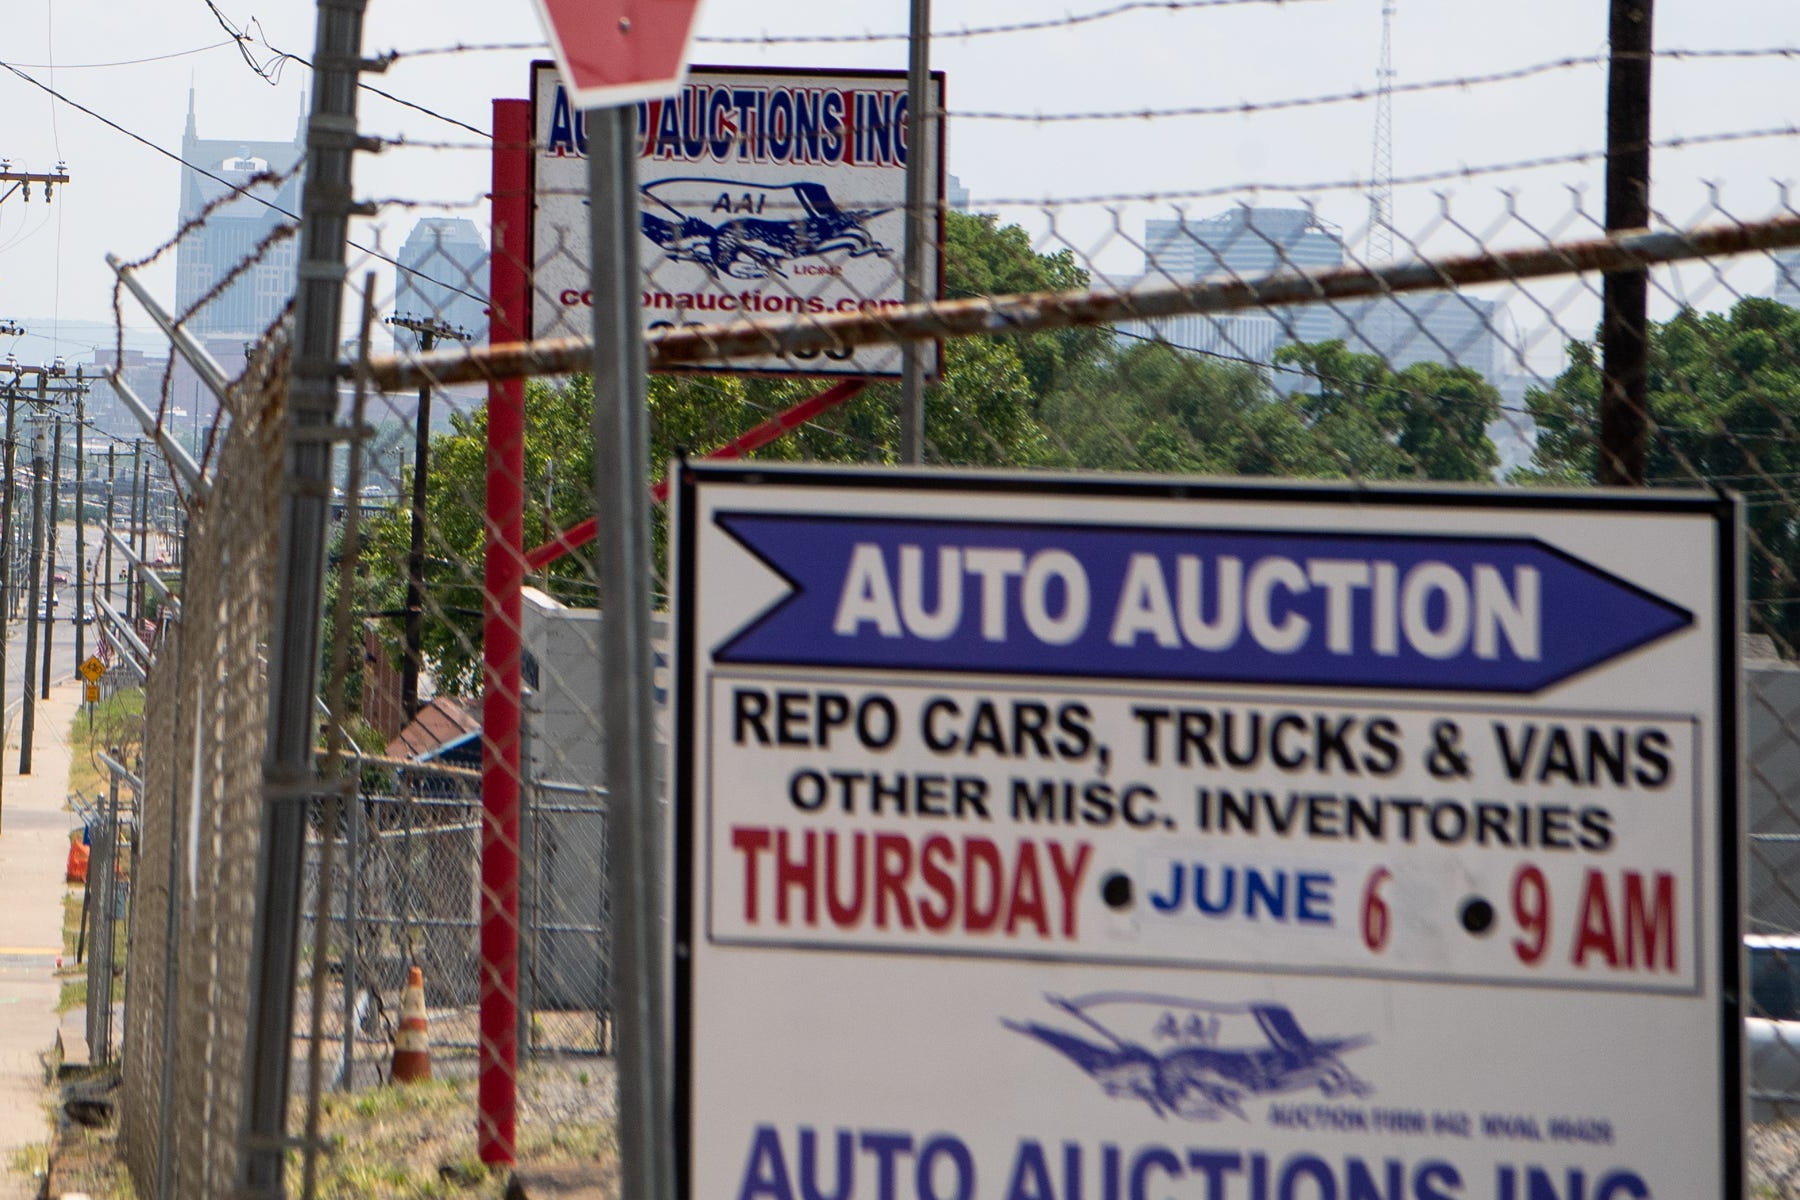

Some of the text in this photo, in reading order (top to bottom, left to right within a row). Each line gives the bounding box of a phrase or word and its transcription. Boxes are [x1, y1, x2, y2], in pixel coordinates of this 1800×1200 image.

[656, 85, 846, 163] AUCTIONS
[711, 192, 766, 215] AAI
[834, 543, 1541, 661] AUTO AUCTION
[732, 689, 1673, 789] REPO CARS, TRUCKS & VANS
[787, 769, 1615, 852] OTHER MISC. INVENTORIES
[732, 827, 1678, 972] THURSDAY JUNE 6 9 AM
[736, 1123, 976, 1200] AUTO
